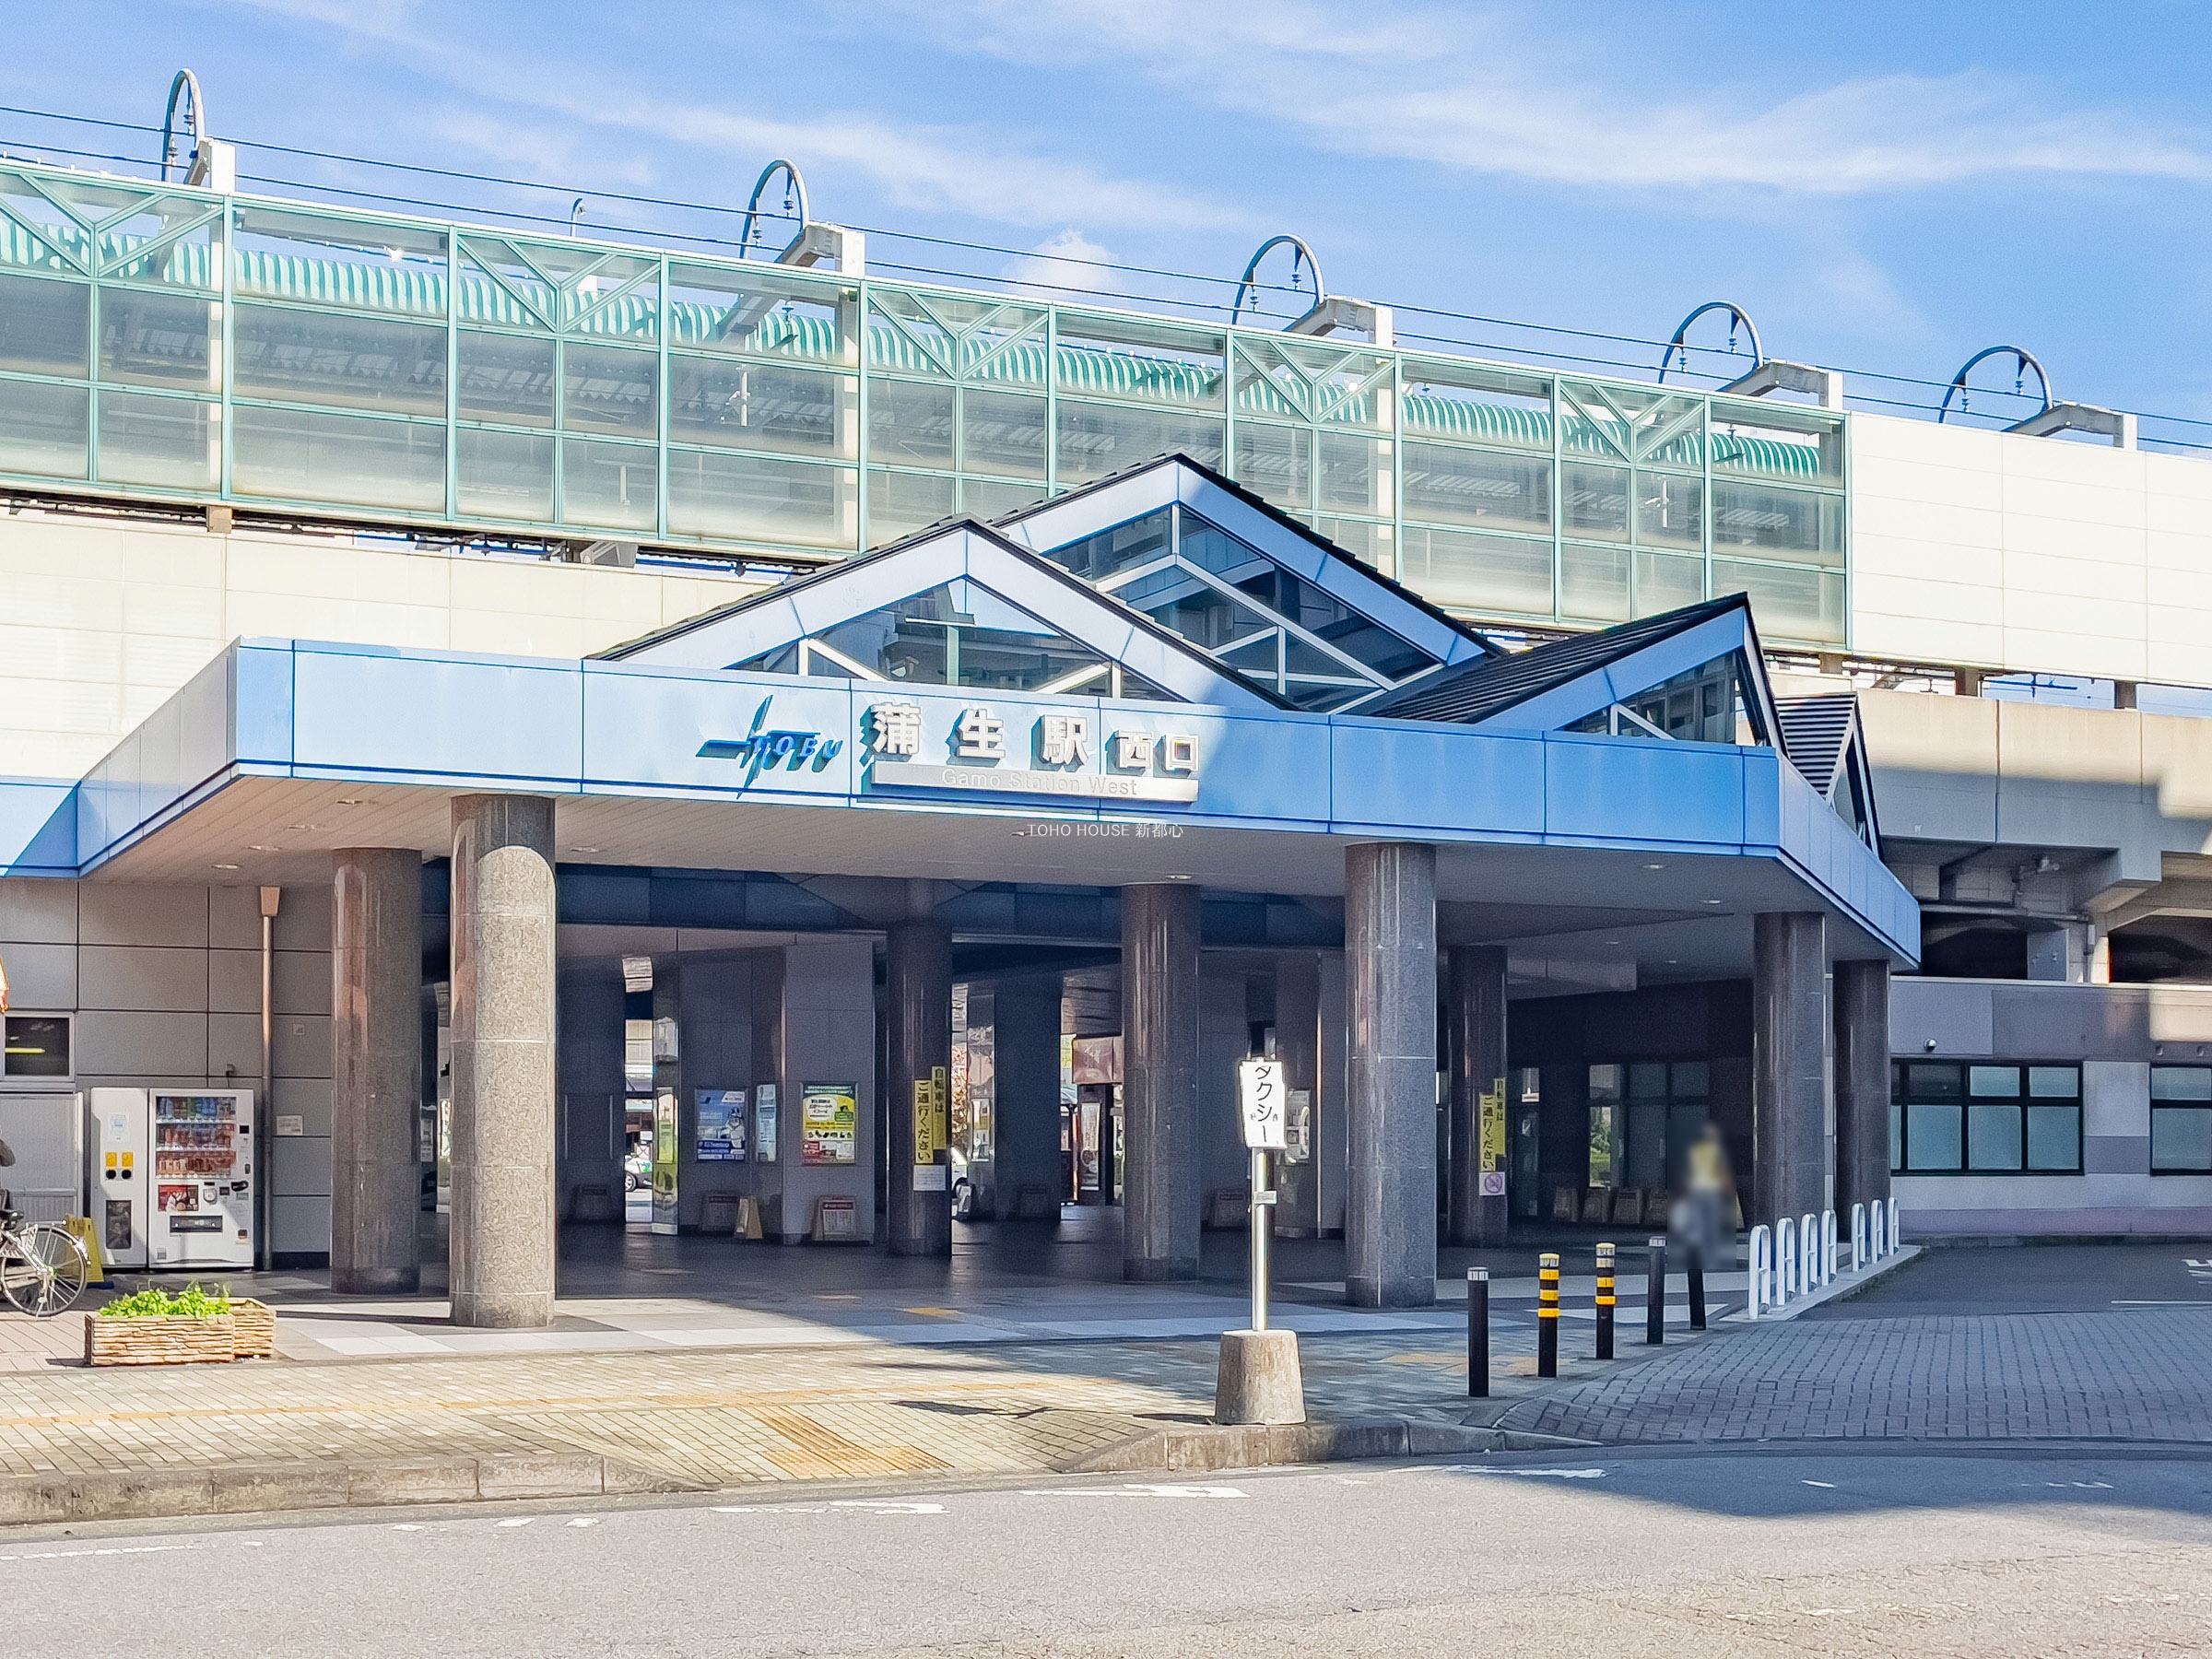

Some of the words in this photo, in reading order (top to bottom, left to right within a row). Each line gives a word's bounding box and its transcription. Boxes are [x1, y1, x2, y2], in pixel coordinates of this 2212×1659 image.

[872, 702, 1199, 771] 蒲生駅西口
[941, 768, 1002, 788] Gamo
[1009, 771, 1080, 794] Station
[1088, 775, 1137, 795] West
[918, 1081, 930, 1160] ご通行ください
[1254, 1065, 1272, 1143] タクシー
